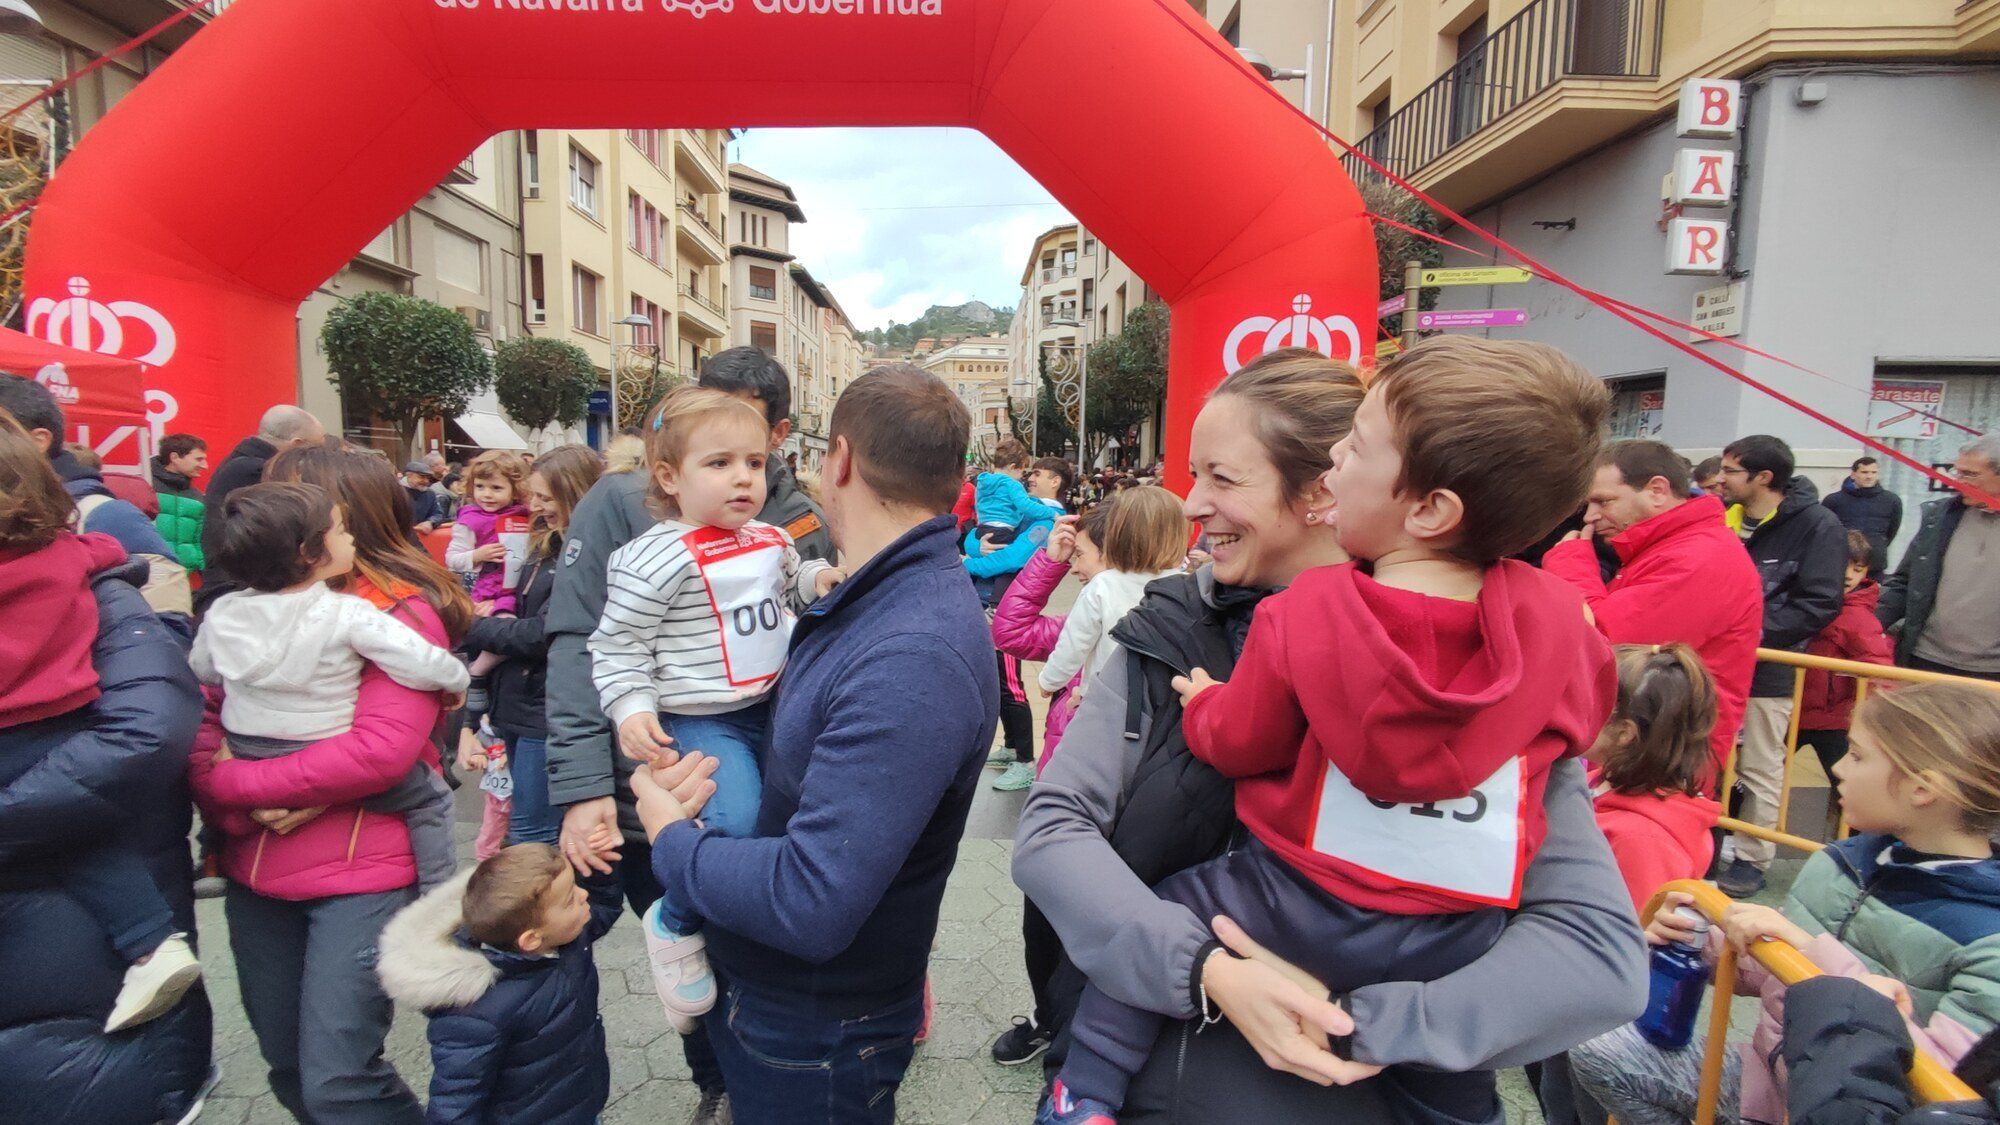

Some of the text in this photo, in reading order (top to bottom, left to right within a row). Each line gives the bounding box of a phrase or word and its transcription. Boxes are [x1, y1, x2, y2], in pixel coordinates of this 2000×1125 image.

[752, 0, 942, 15] Gobernua
[1687, 86, 1731, 265] BAR
[1873, 388, 1940, 403] arasate
[733, 597, 783, 637] 00
